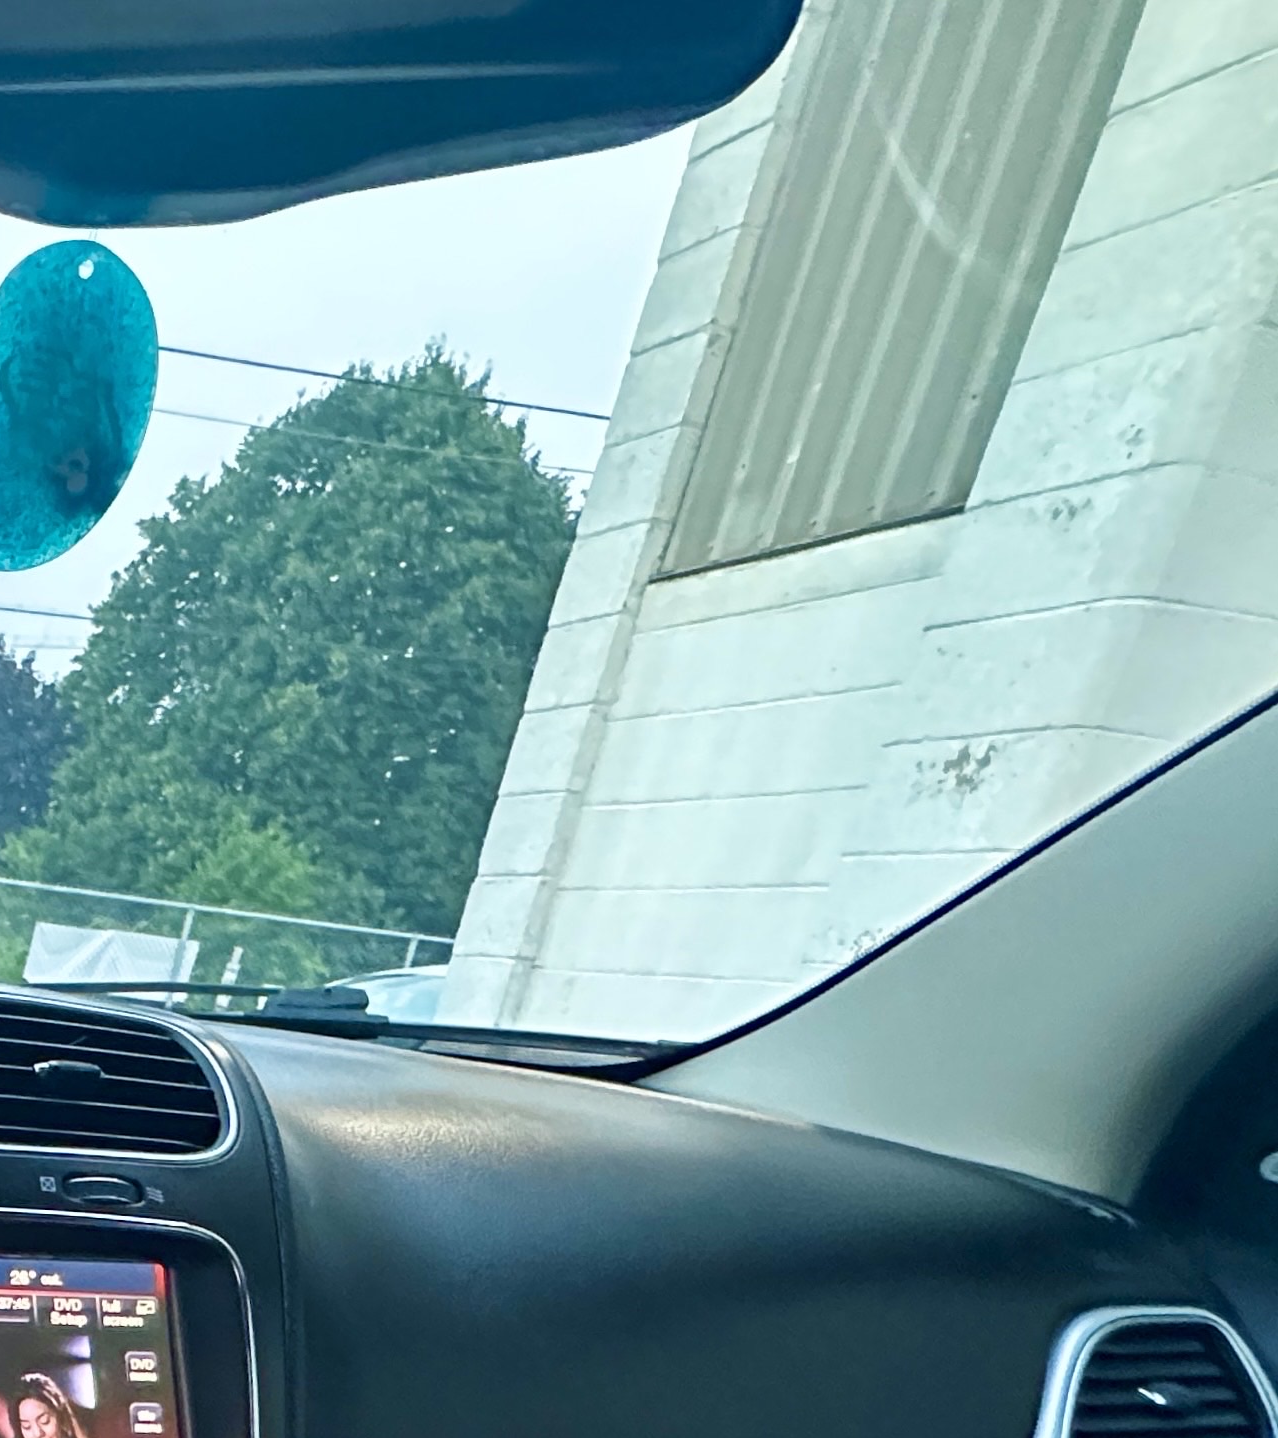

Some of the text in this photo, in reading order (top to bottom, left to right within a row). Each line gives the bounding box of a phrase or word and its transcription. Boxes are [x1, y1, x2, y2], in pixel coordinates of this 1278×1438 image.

[53, 1299, 82, 1311] DVD
[50, 1313, 87, 1327] Setup
[129, 1358, 155, 1370] DVD
